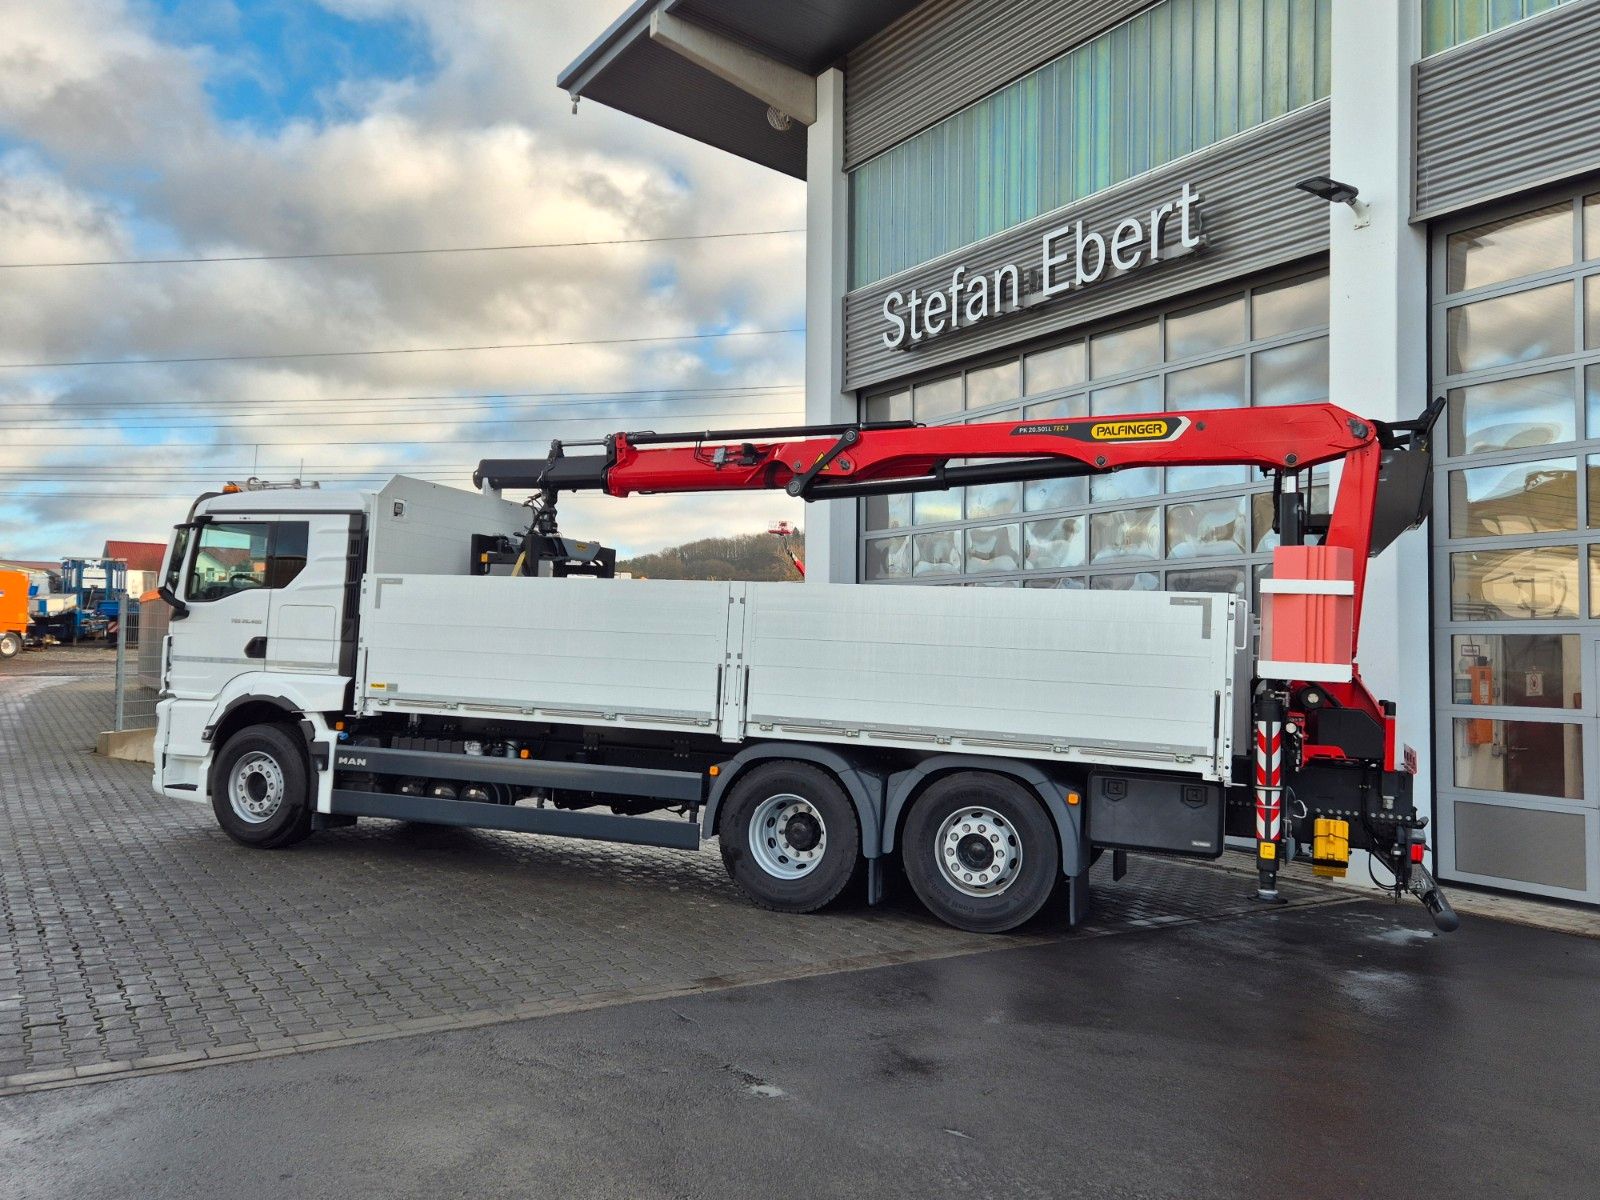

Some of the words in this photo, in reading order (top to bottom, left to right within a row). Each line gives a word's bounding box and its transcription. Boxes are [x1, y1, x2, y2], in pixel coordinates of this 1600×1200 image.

[882, 264, 1020, 348] Stefan
[1042, 183, 1200, 297] Ebert
[1096, 423, 1162, 436] PALFINGER
[338, 757, 367, 766] MAN
